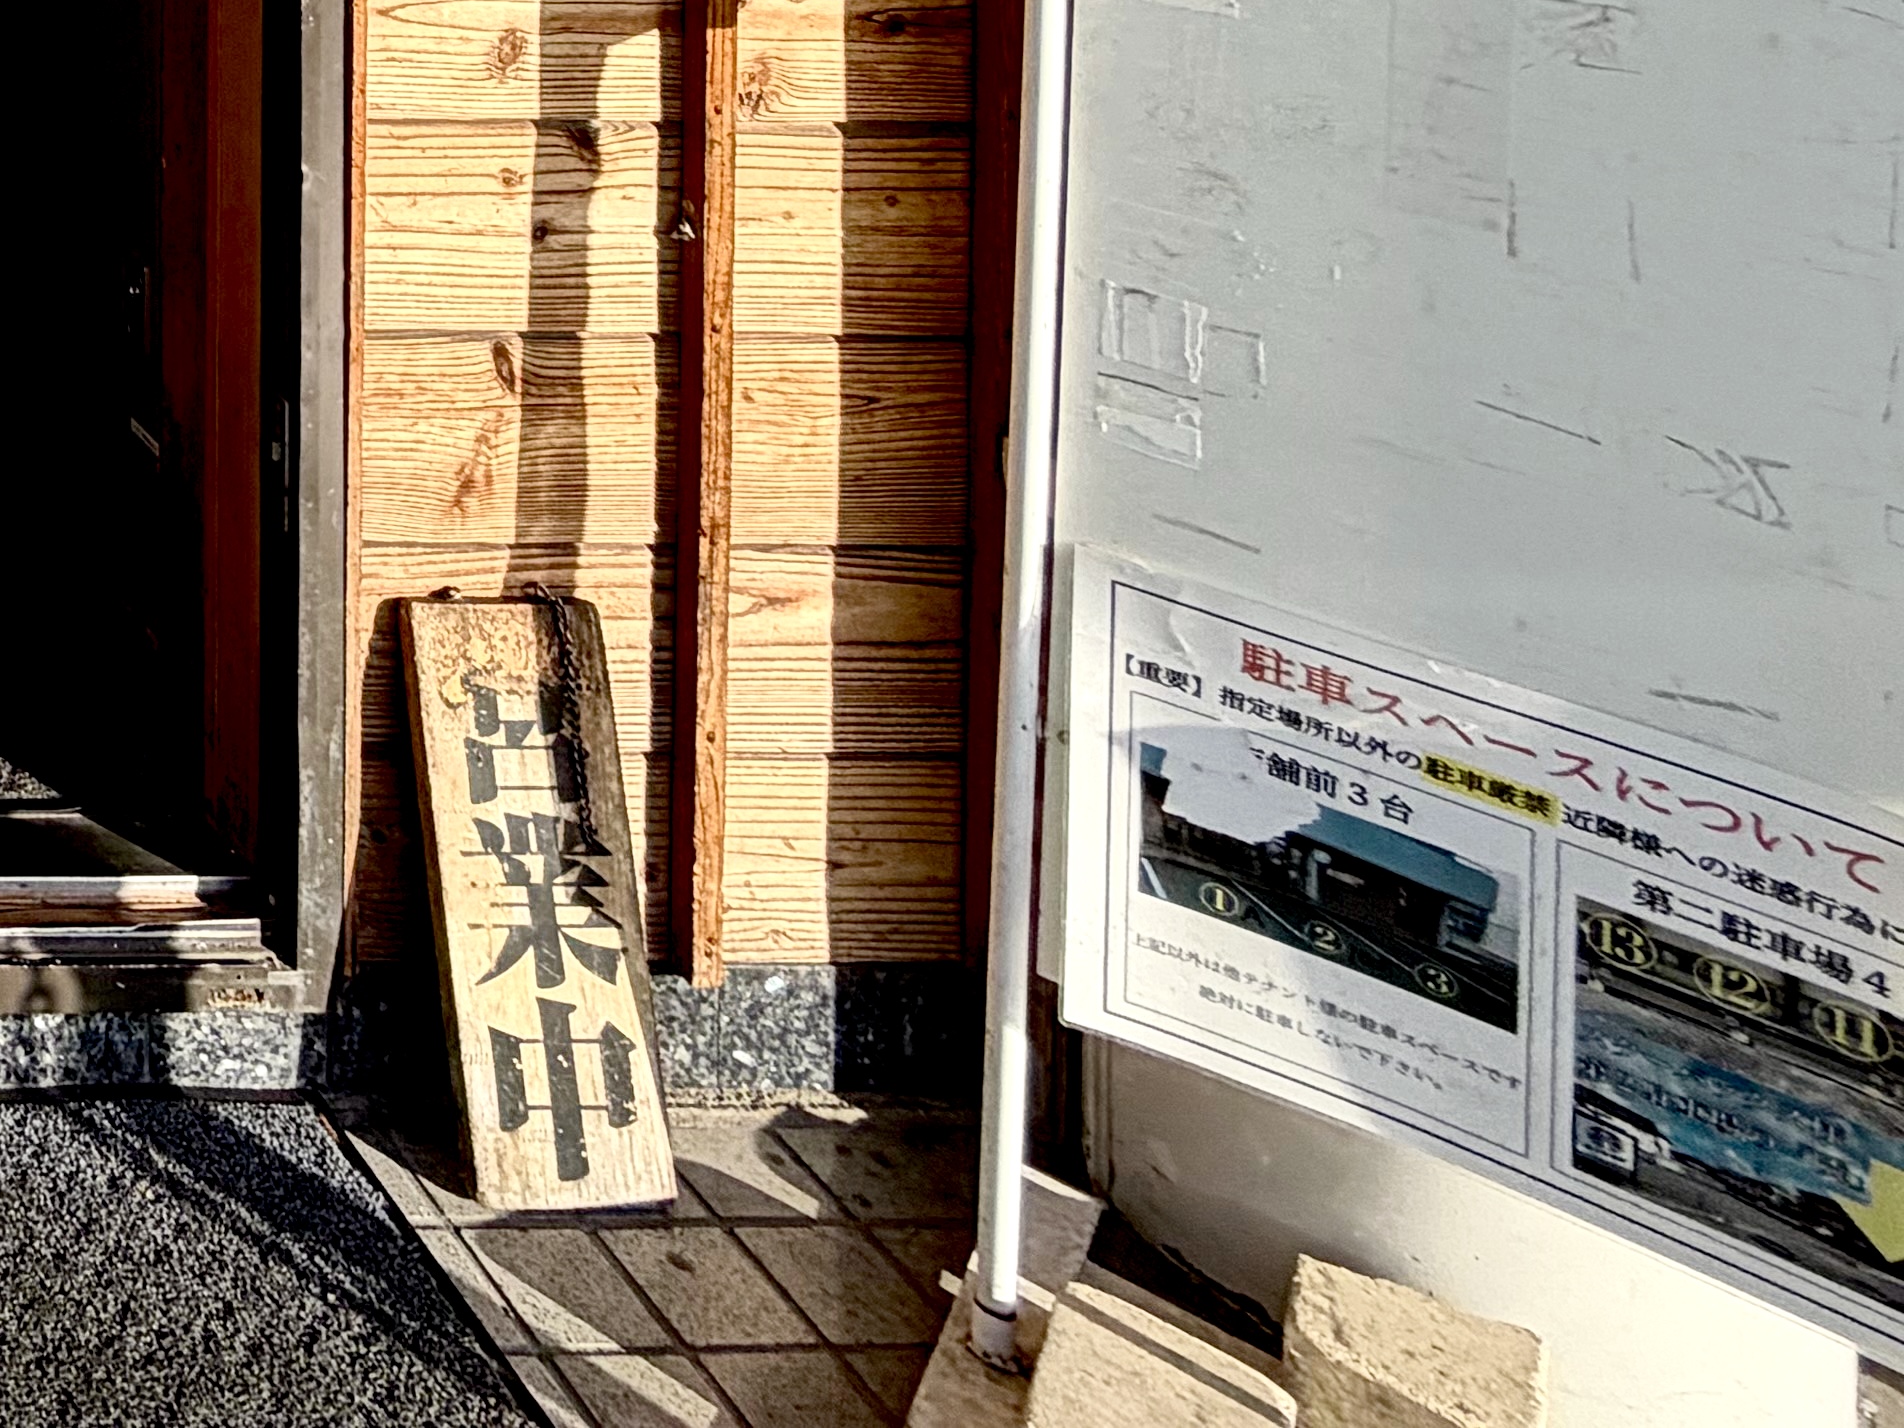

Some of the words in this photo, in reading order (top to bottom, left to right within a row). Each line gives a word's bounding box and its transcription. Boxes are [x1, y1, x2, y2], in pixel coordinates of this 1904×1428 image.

[1125, 653, 1202, 698] 【重要】
[1242, 638, 1885, 893] 駐車スペースについて
[1250, 747, 1414, 825] 舗前3台
